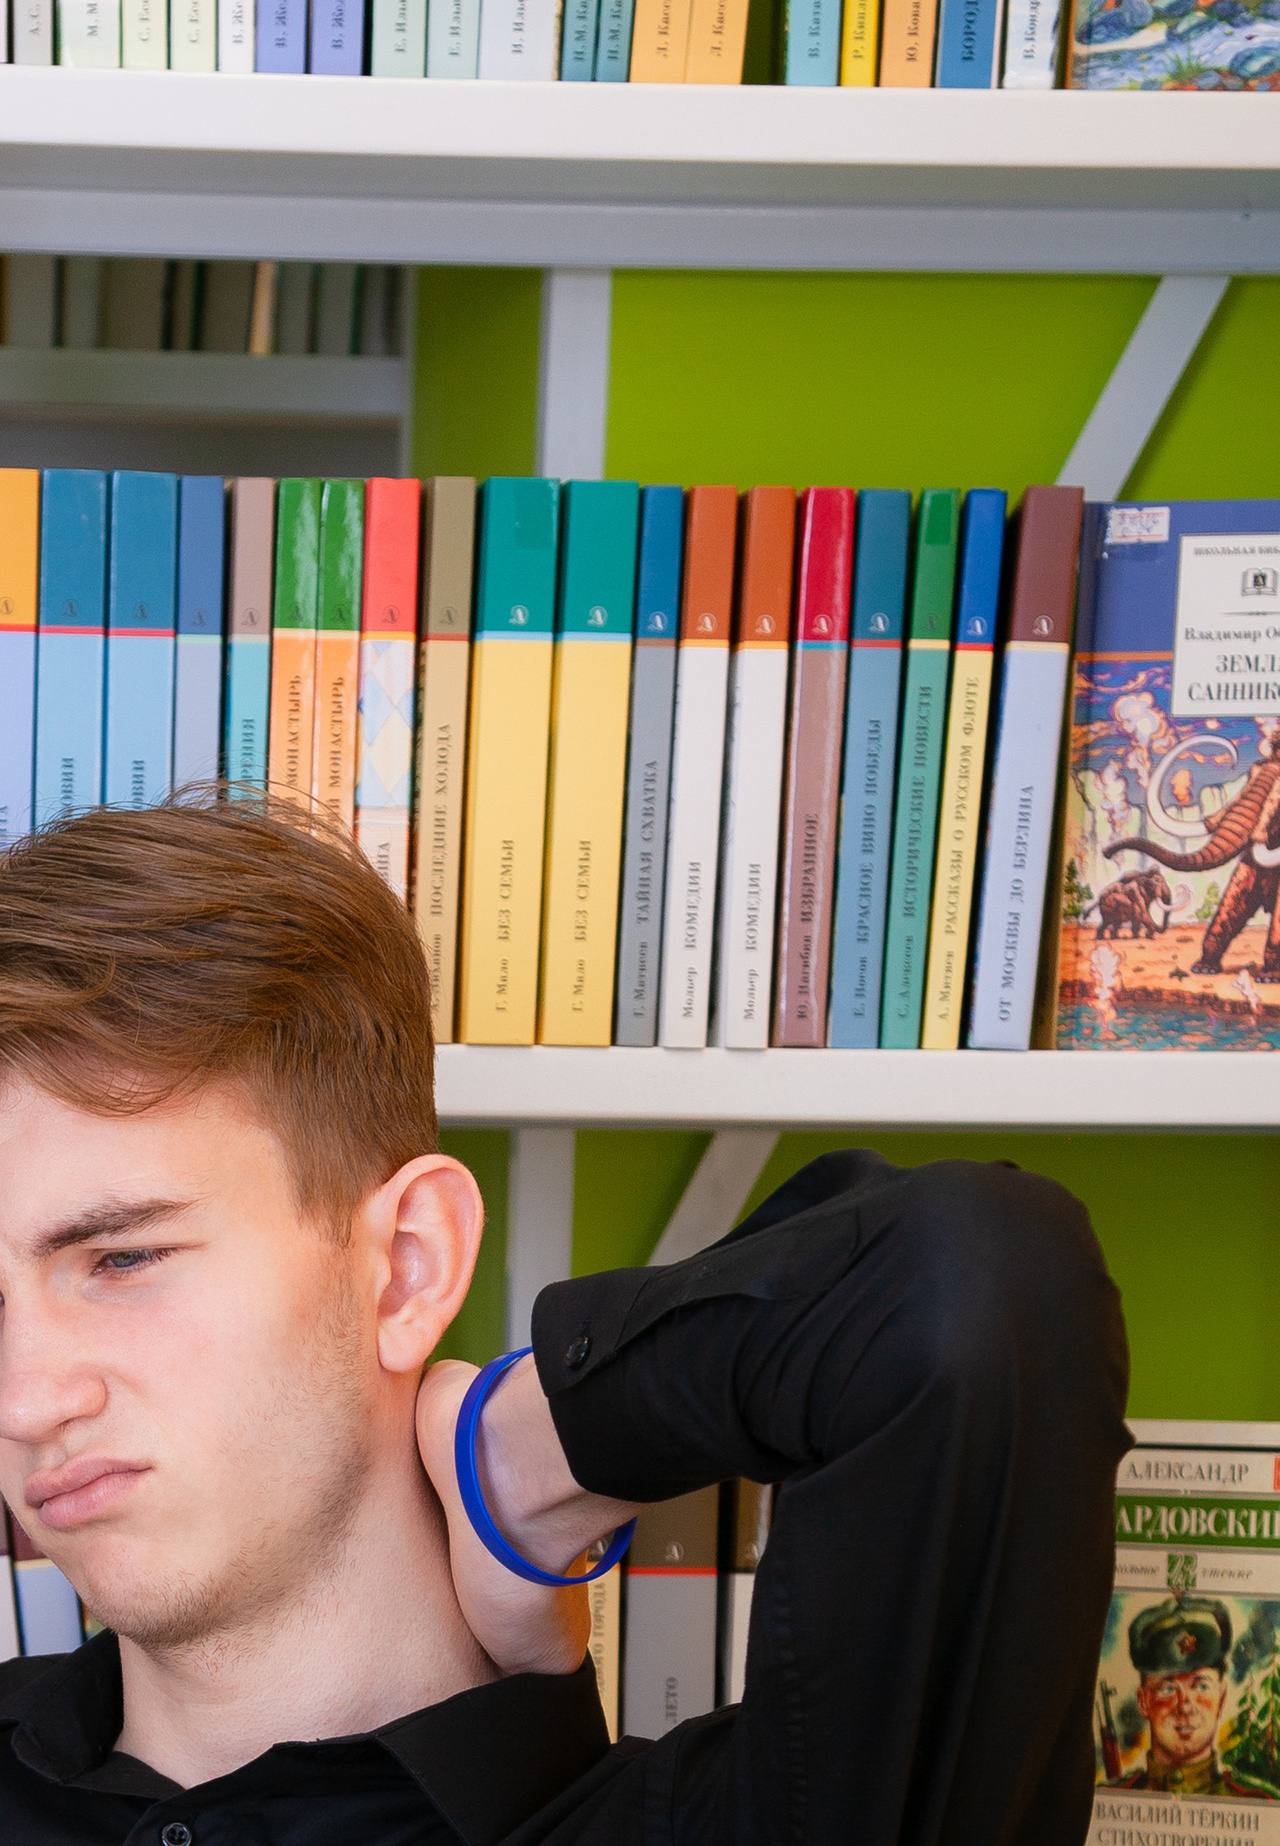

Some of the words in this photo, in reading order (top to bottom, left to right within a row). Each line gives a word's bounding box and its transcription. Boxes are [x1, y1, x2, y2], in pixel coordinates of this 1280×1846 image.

[1185, 627, 1261, 642] Владимир
[1216, 654, 1280, 673] ЗЕМЛ
[284, 674, 303, 786] МОНАСТЫРЬ
[326, 675, 346, 788] МОНАСТЫРЬ
[913, 685, 934, 768] ПОВЕСТИ
[960, 676, 980, 736] ФЛОТЕ
[434, 722, 452, 796] ХОЛОДА
[863, 718, 883, 796] ПОБЕДЫ
[953, 744, 974, 821] РУССКОМ
[639, 759, 659, 842] СХВАТКА
[860, 802, 878, 855] ВИНО
[952, 828, 965, 841] О
[1009, 784, 1035, 871] БЕРЛИНА
[429, 804, 449, 916] ПОСЛЕДНИЕ
[498, 839, 516, 900] СЕМЬИ
[575, 839, 593, 901] СЕМЬИ
[800, 813, 819, 923] ИЗБРАННОЕ
[901, 775, 927, 918] ИСТОРИЧЕСКИЕ
[633, 850, 655, 925] ТАЙНАЯ
[683, 860, 703, 950] КОМЕДИИ
[744, 862, 763, 951] КОМЕДИИ
[855, 861, 876, 944] КРАСНОЕ
[942, 849, 964, 936] РАССКАЗЫ
[1007, 878, 1024, 902] ДО
[497, 908, 513, 942] БЕЗ
[574, 909, 589, 942] БЕЗ
[998, 910, 1020, 989] МОСКВЫ
[497, 958, 511, 995] Мало
[573, 958, 588, 996] Мало
[997, 997, 1013, 1022] ОТ
[1127, 1461, 1249, 1484] АЛЕКСАНДР
[1117, 1505, 1280, 1541] АРДОВСКИ
[1095, 1801, 1182, 1826] ВАСИЛИЙ
[1188, 1808, 1259, 1832] ТЁРКИН
